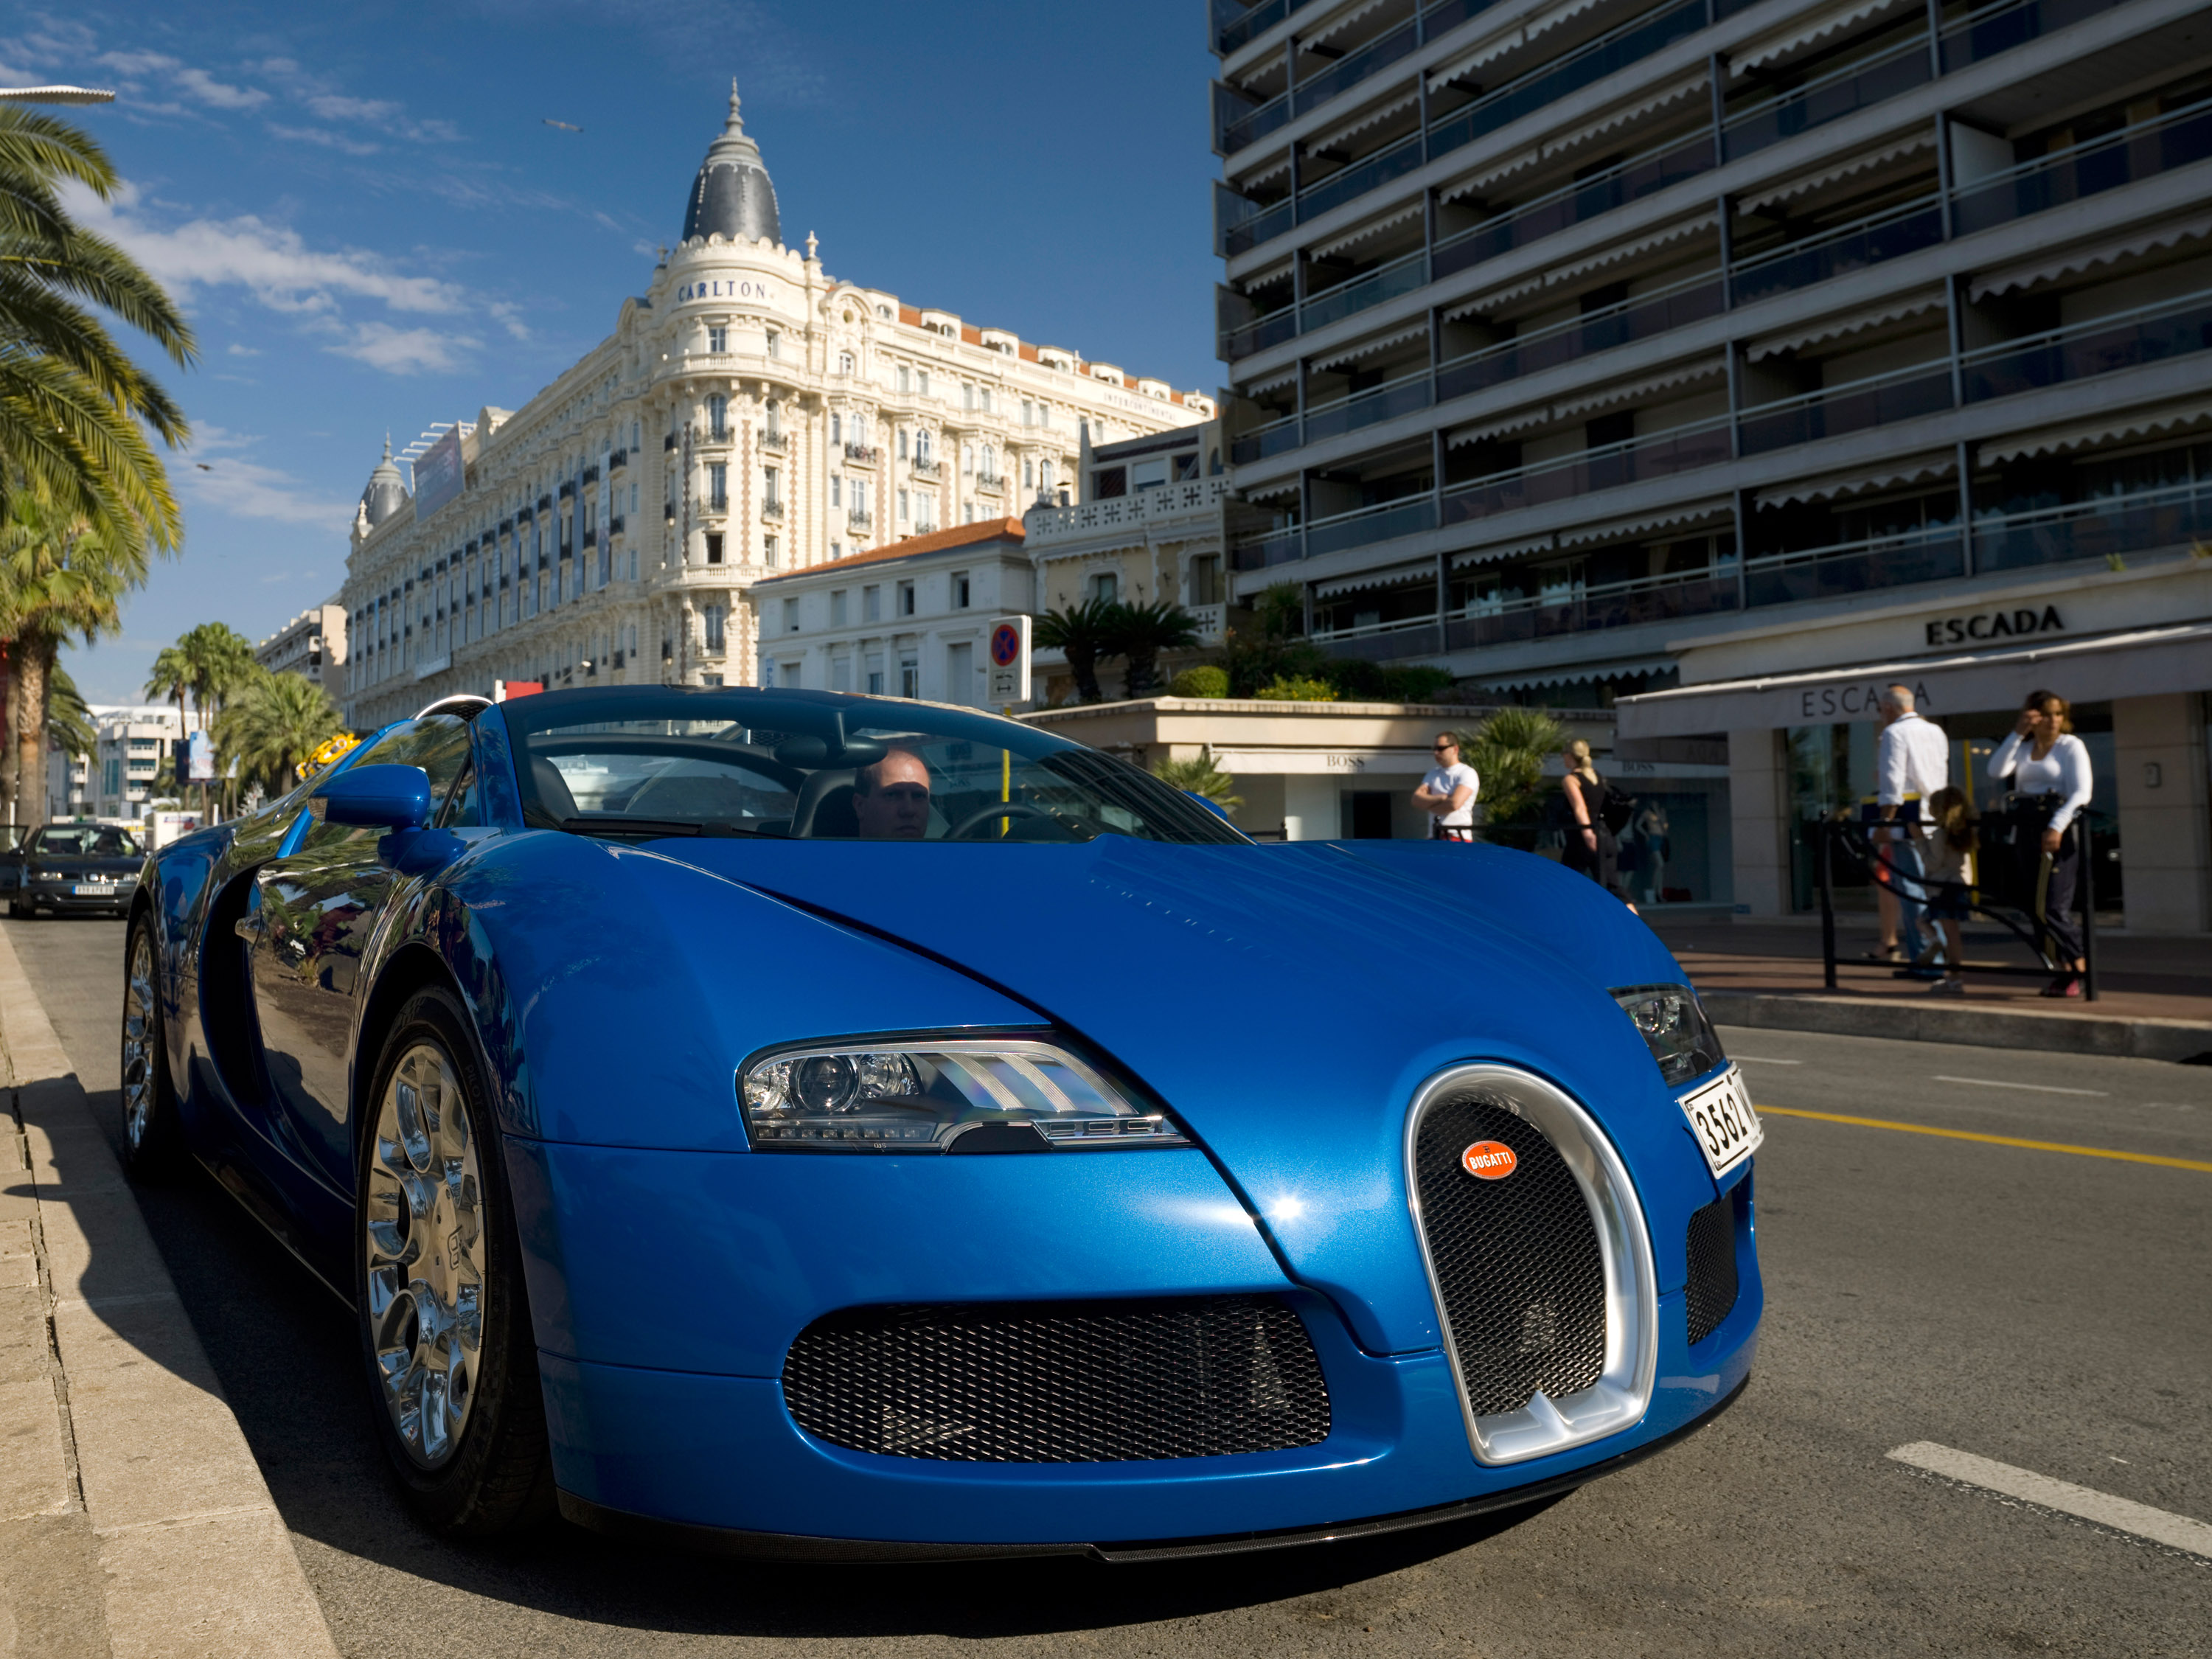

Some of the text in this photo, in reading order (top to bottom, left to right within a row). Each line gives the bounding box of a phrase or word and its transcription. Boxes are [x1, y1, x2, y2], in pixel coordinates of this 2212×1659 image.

[678, 279, 765, 302] CARLTON
[1926, 605, 2063, 646] ESCADA
[1801, 680, 1931, 718] ESCAA
[1327, 755, 1365, 768] BOSS
[1695, 1092, 1748, 1157] 3562
[1468, 1151, 1513, 1170] BUGATTI
